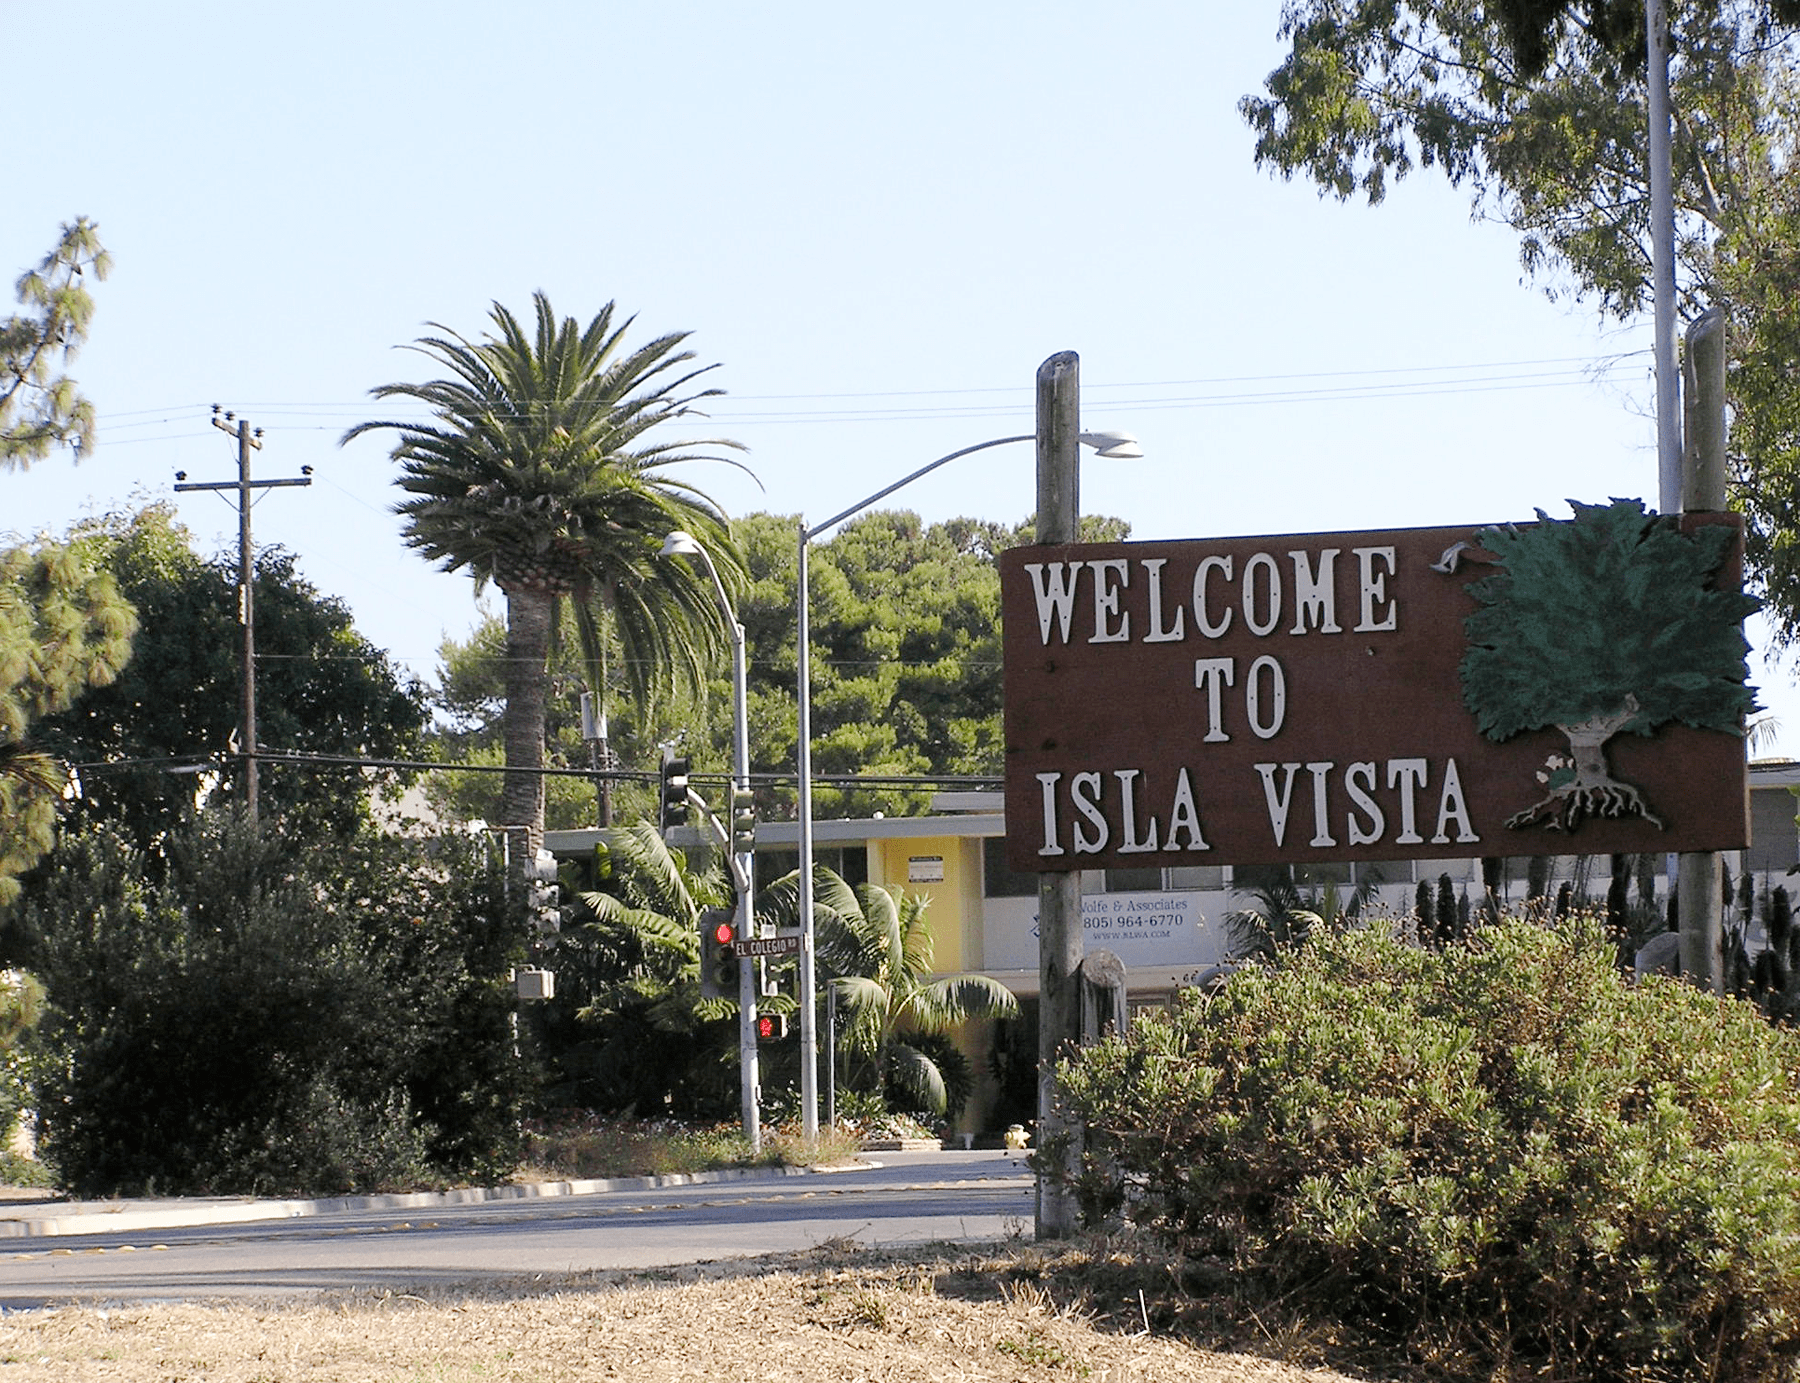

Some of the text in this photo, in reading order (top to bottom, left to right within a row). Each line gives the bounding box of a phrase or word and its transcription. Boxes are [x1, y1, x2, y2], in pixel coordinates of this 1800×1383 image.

[1024, 545, 1397, 645] WELCOME
[1195, 655, 1287, 743] TO
[1035, 757, 1480, 857] ISLA VISTA
[1082, 914, 1183, 929] 805) 964-6770
[1113, 900, 1122, 912] &
[1127, 898, 1188, 912] Associates
[736, 943, 746, 956] EL
[750, 939, 786, 955] COLEGIO
